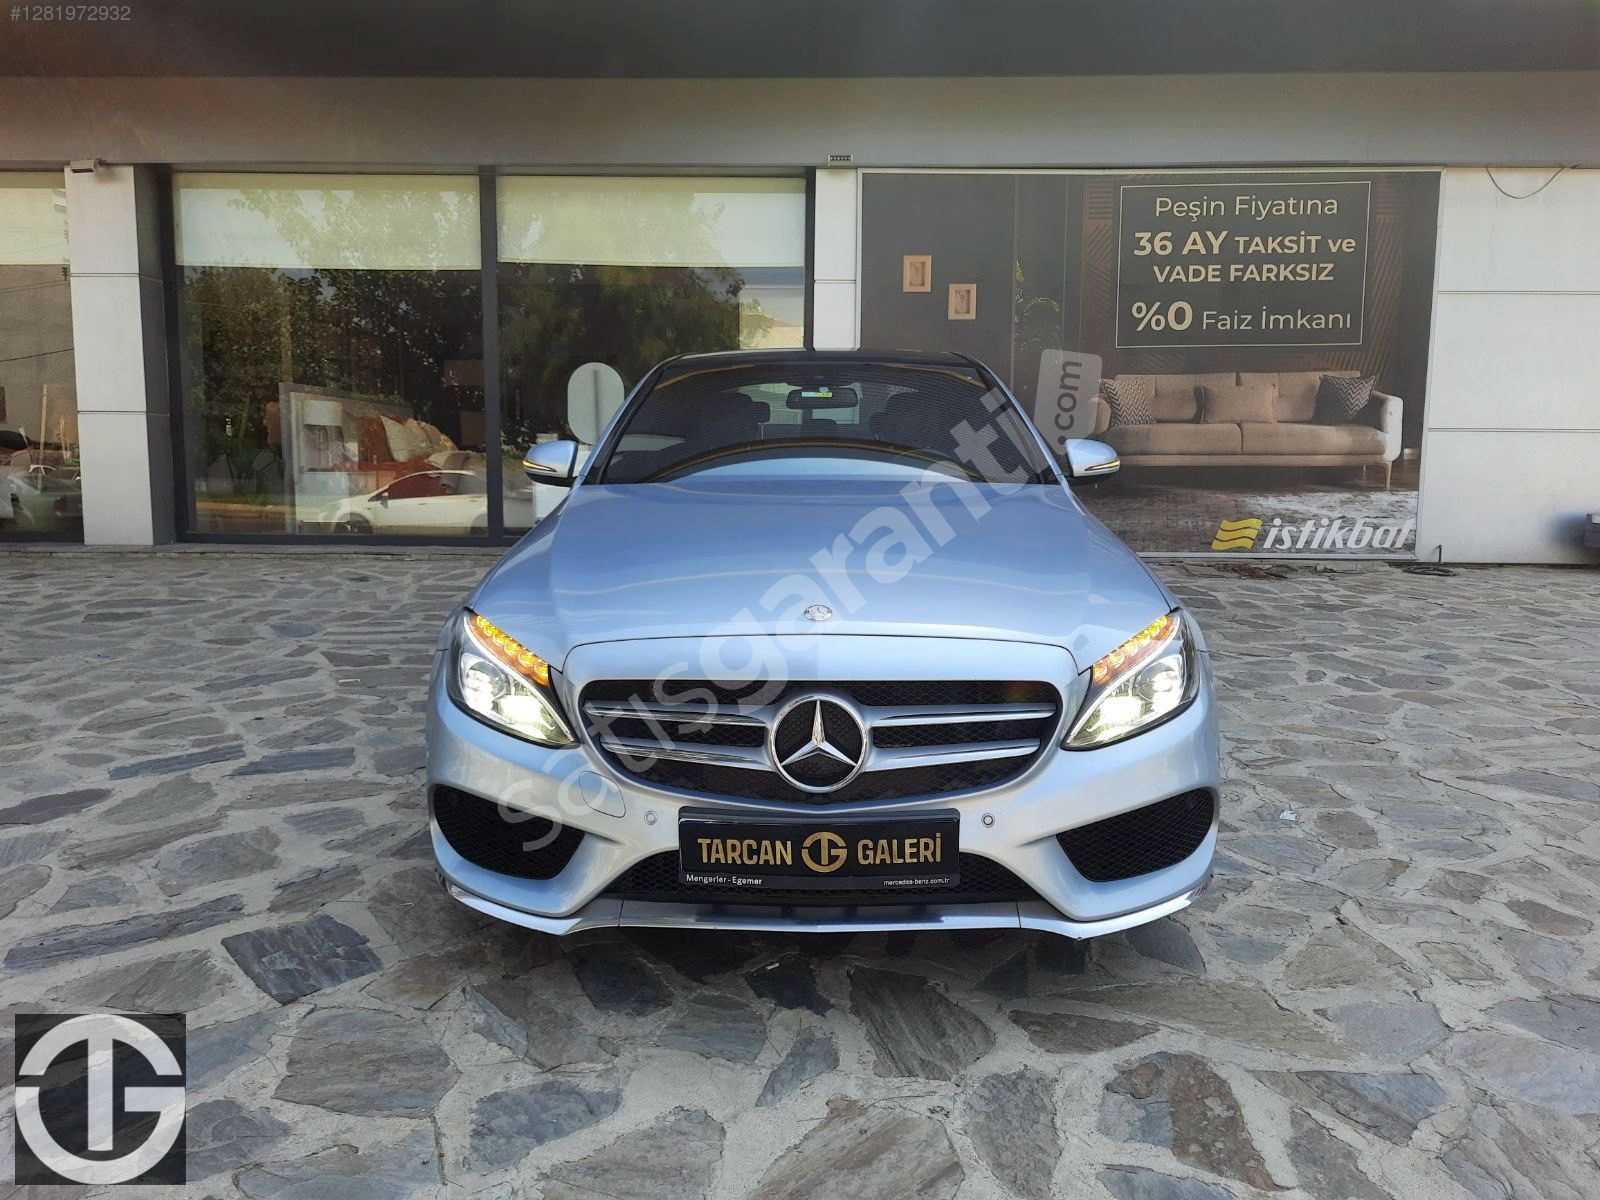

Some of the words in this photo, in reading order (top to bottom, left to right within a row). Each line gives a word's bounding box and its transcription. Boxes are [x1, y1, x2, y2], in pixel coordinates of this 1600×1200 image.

[1155, 196, 1225, 222] Peşin
[1235, 195, 1339, 221] Fiyatına
[1133, 231, 1173, 256] 36
[1182, 231, 1229, 255] AY
[1235, 231, 1322, 254] TAKSİT
[1328, 238, 1357, 253] ve
[1153, 264, 1222, 283] VADE
[1229, 263, 1335, 282] FARKSIZ
[1131, 301, 1193, 332] %0
[1202, 309, 1253, 331] Faiz
[1261, 306, 1351, 331] İmkanı
[1262, 517, 1416, 550] istikbal
[697, 837, 792, 866] TARCAN
[857, 833, 942, 865] GALERİ
